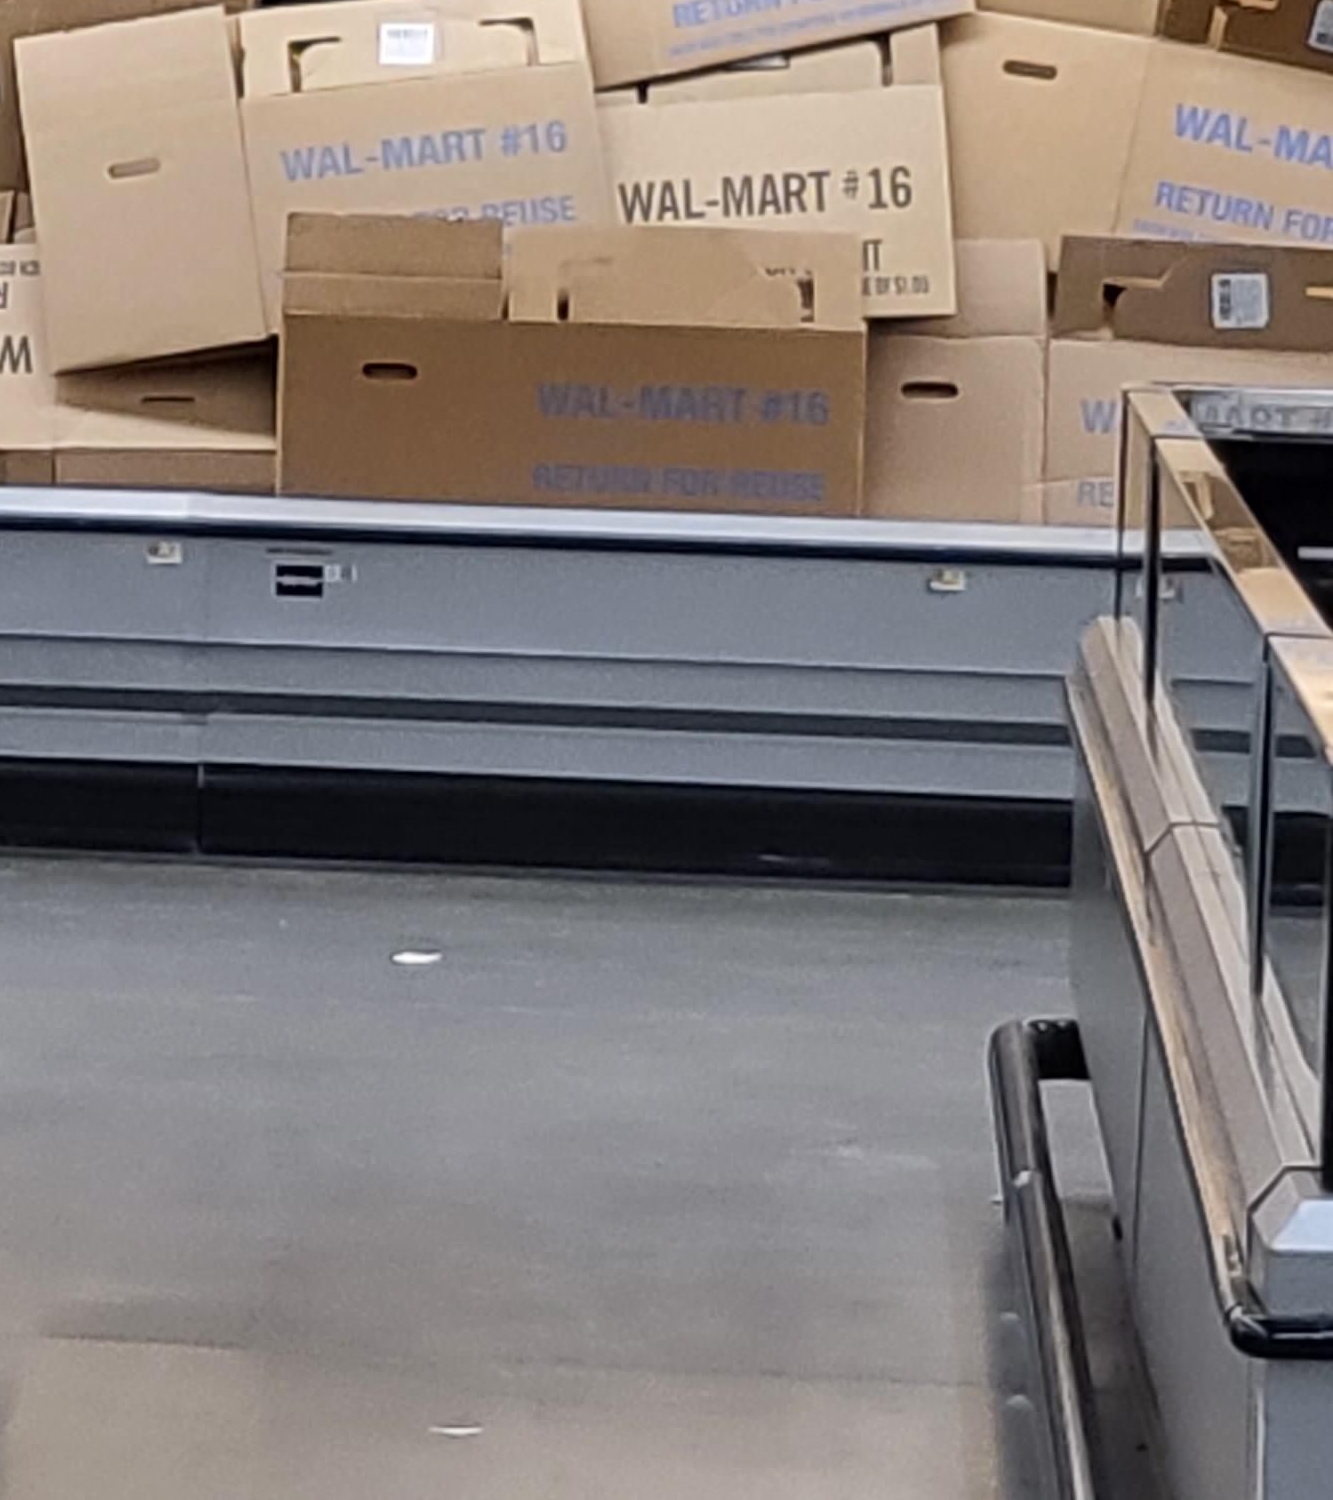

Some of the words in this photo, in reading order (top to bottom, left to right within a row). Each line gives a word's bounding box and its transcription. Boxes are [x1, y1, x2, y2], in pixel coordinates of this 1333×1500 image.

[279, 127, 487, 183] WAL-MART
[500, 118, 568, 158] #16
[1174, 102, 1333, 171] WAL-MA
[618, 170, 831, 225] WAL-MART
[842, 165, 913, 211] #16
[1155, 180, 1276, 232] RETURN
[537, 381, 748, 425] WAL-MART
[760, 388, 830, 427] #16
[534, 462, 654, 495] RETURN
[660, 467, 719, 497] FOR
[731, 469, 825, 502] REUSE
